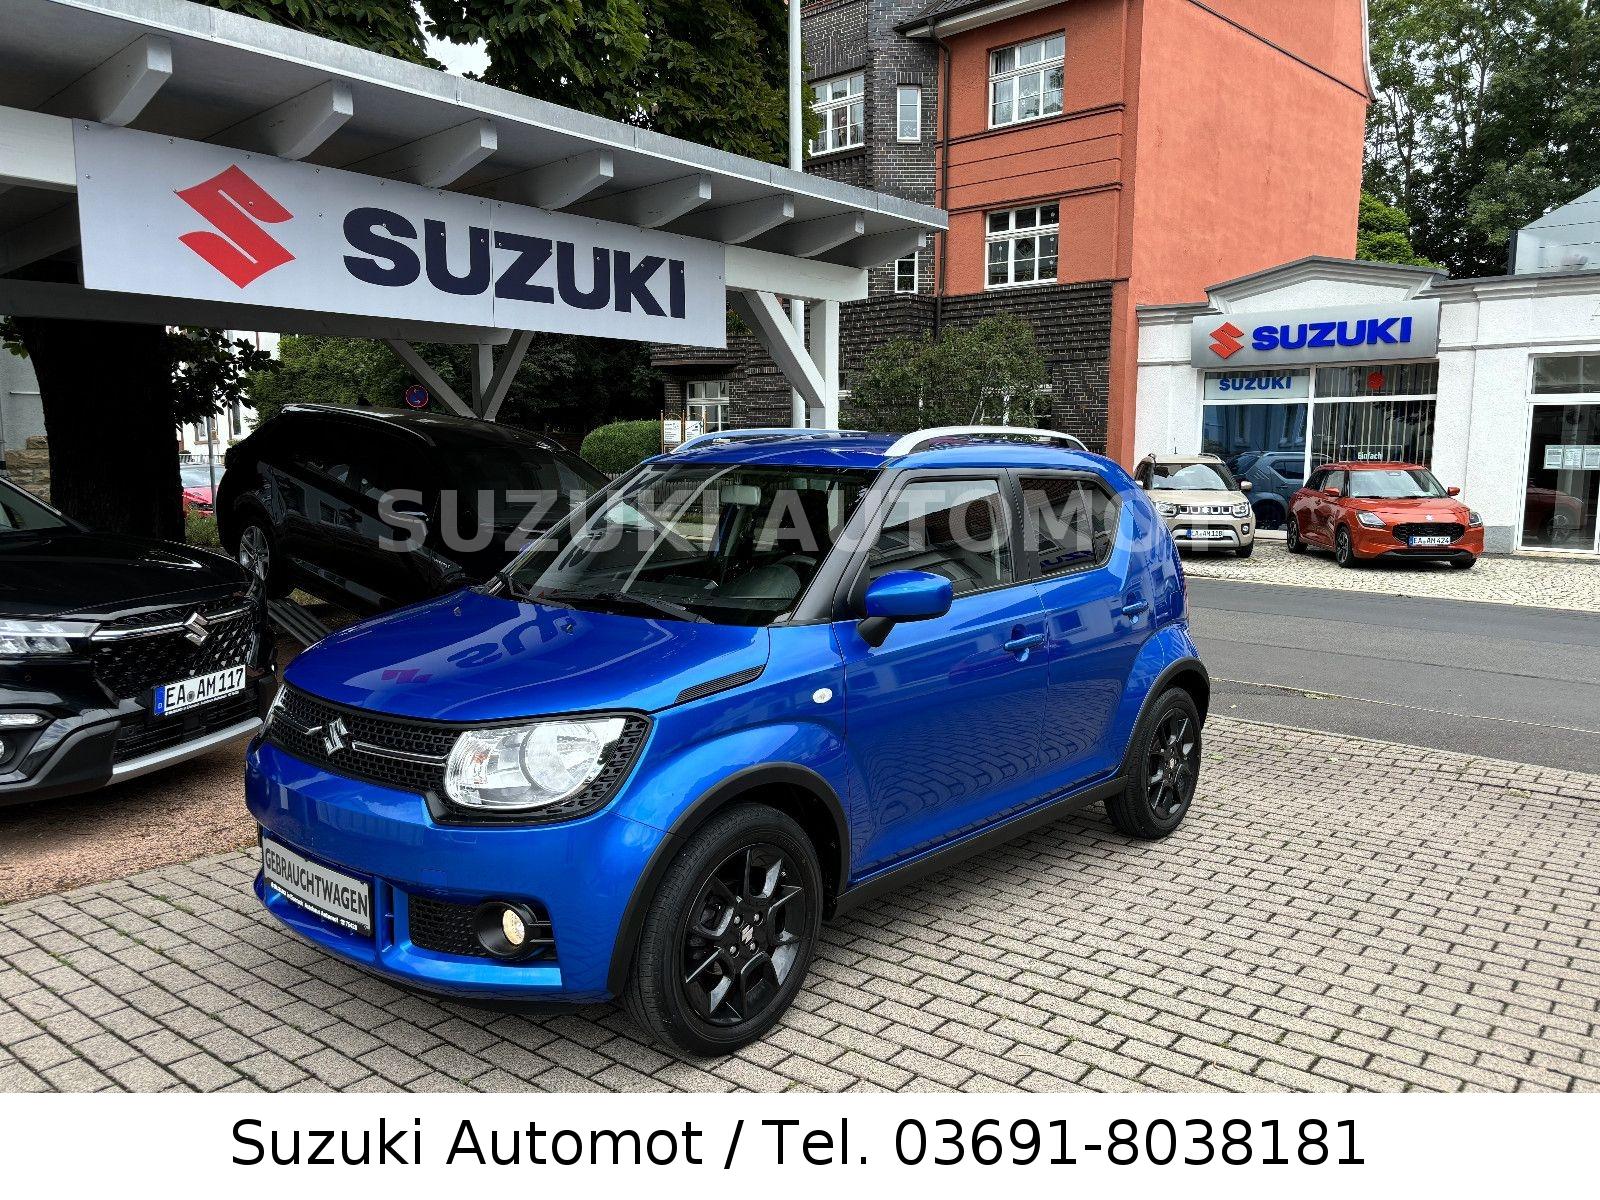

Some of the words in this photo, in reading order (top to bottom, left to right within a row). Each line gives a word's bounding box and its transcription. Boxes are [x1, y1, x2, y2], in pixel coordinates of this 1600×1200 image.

[343, 207, 686, 320] SUZUKI
[1252, 316, 1412, 351] SUZUKI
[1218, 376, 1293, 392] SUZUKI
[165, 684, 186, 708] EA
[197, 675, 217, 700] AM
[218, 667, 244, 693] 117
[265, 847, 368, 917] GEBRAUCHTWAGEN
